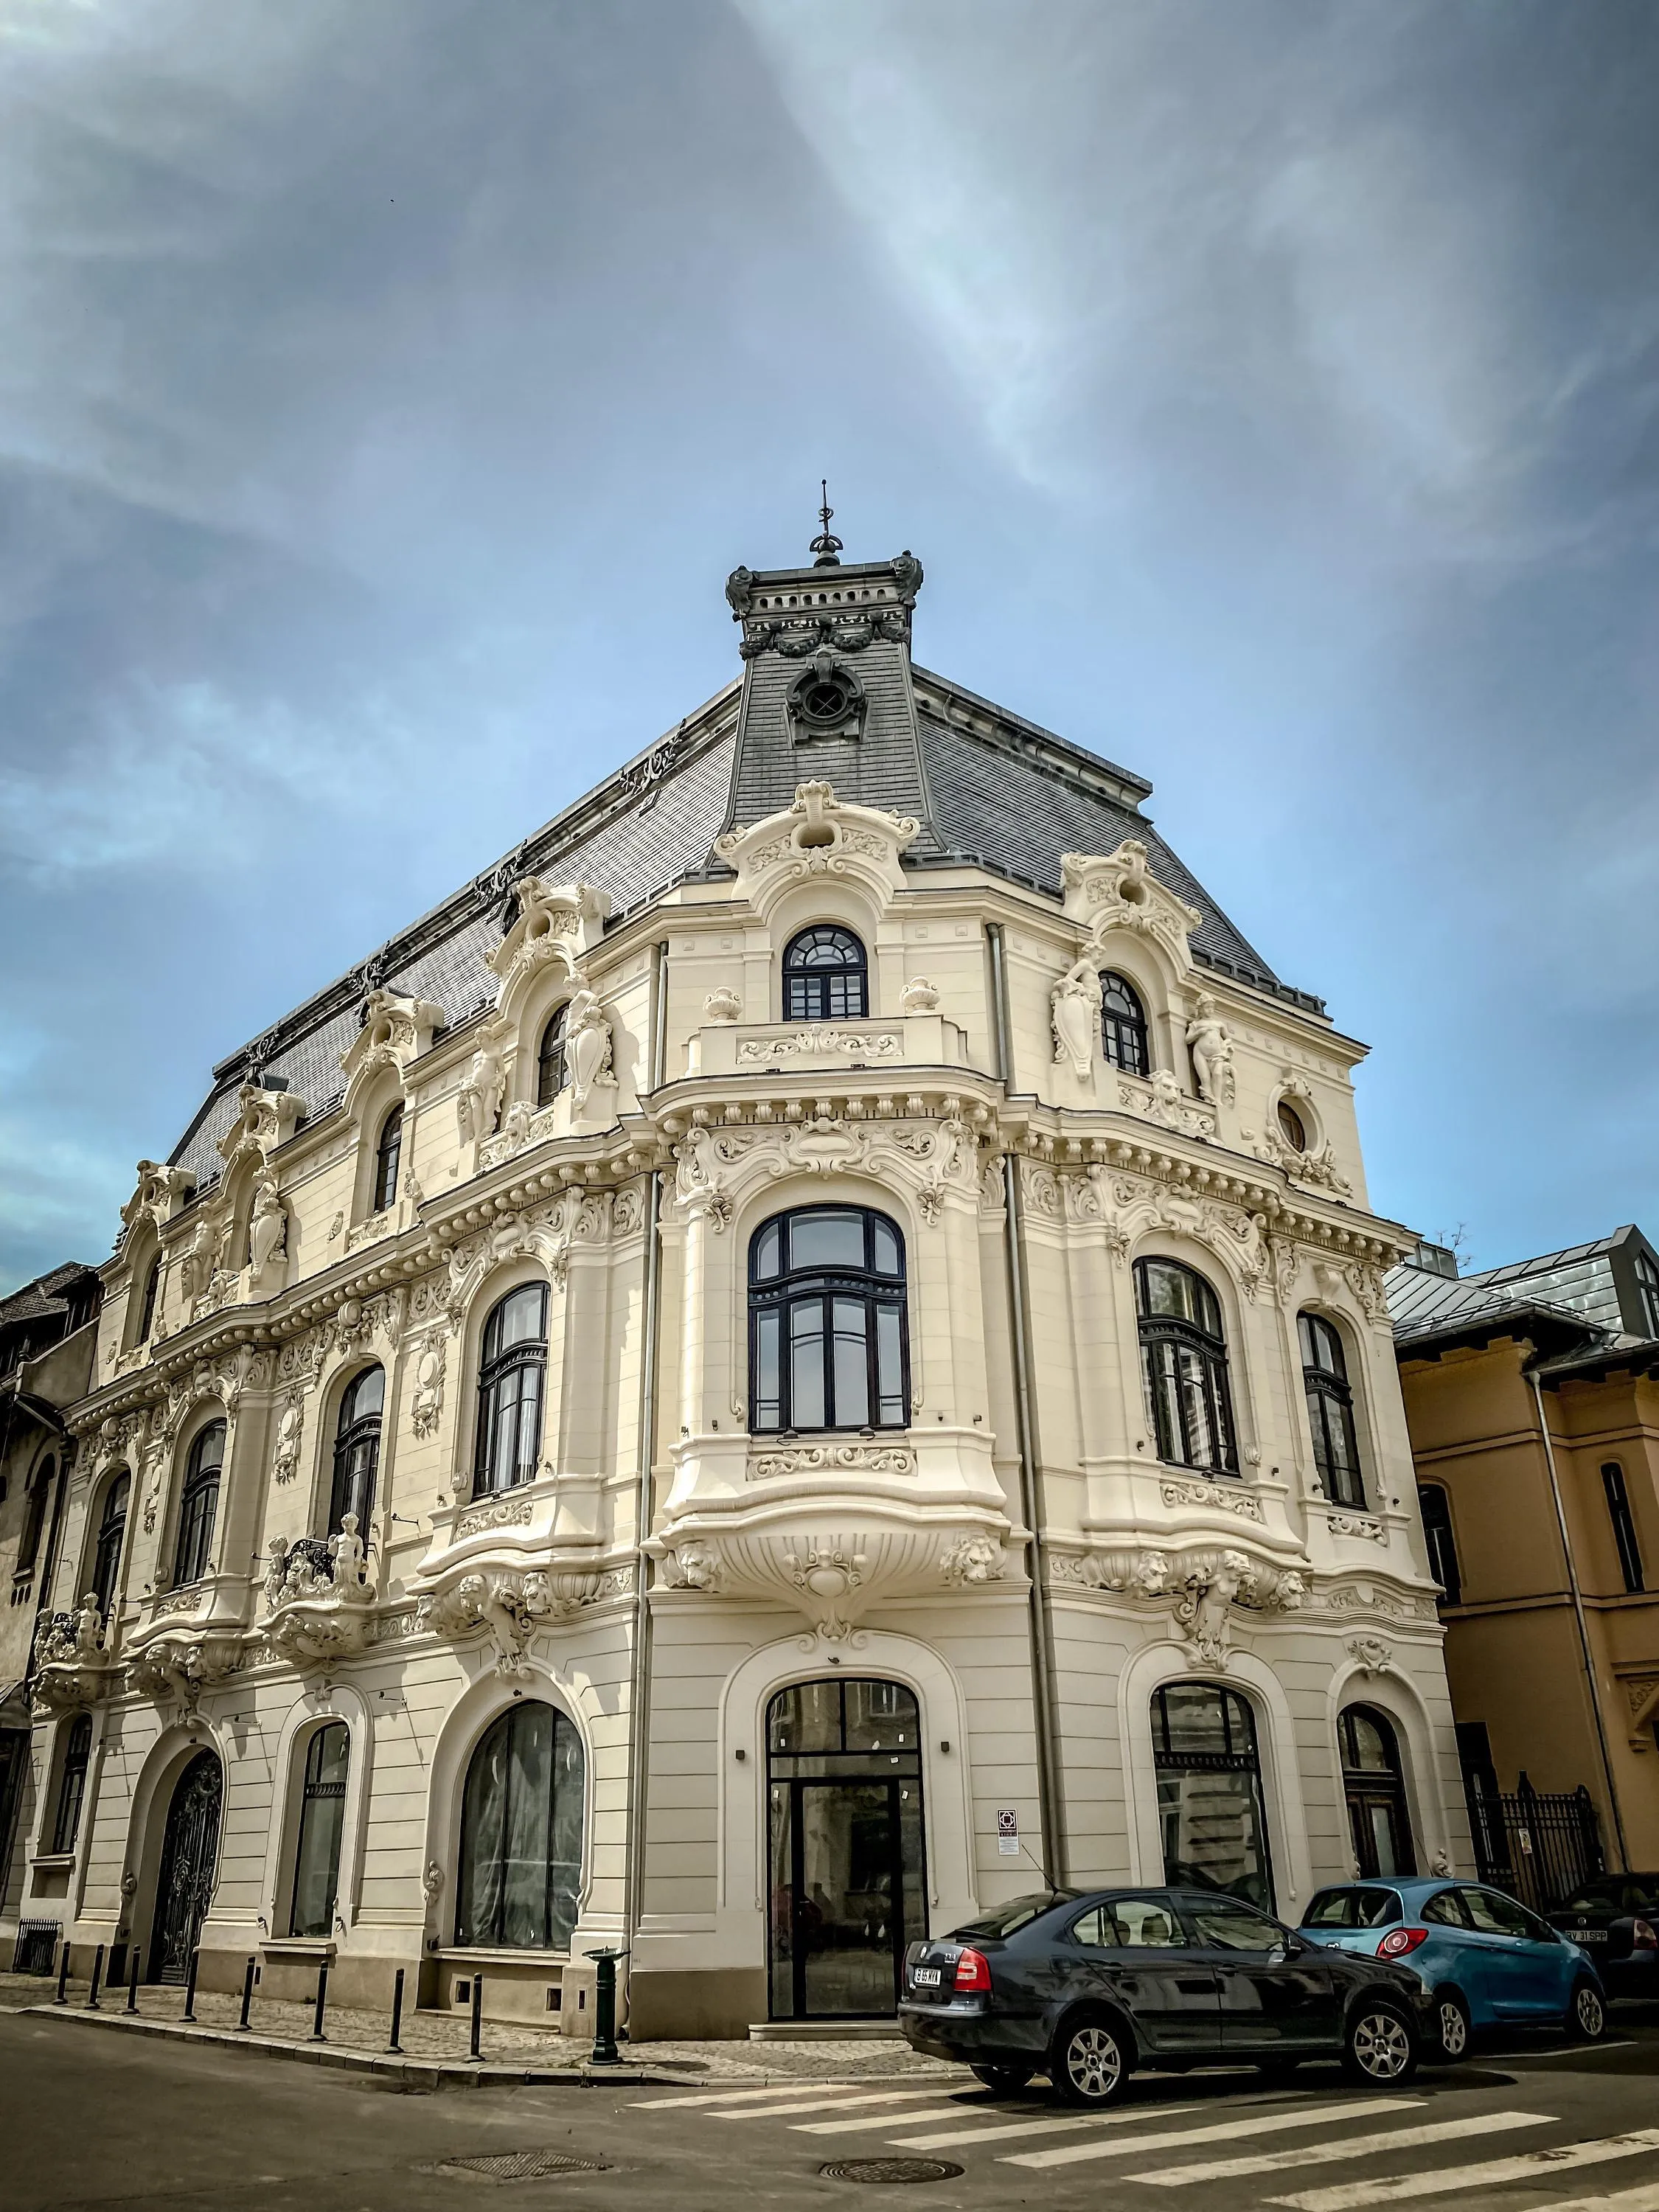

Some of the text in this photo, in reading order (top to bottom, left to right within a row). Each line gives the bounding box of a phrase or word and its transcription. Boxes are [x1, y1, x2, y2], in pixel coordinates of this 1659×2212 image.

[1580, 1932, 1587, 1940] 31
[1590, 1932, 1607, 1940] SPP
[917, 1969, 921, 1981] B
